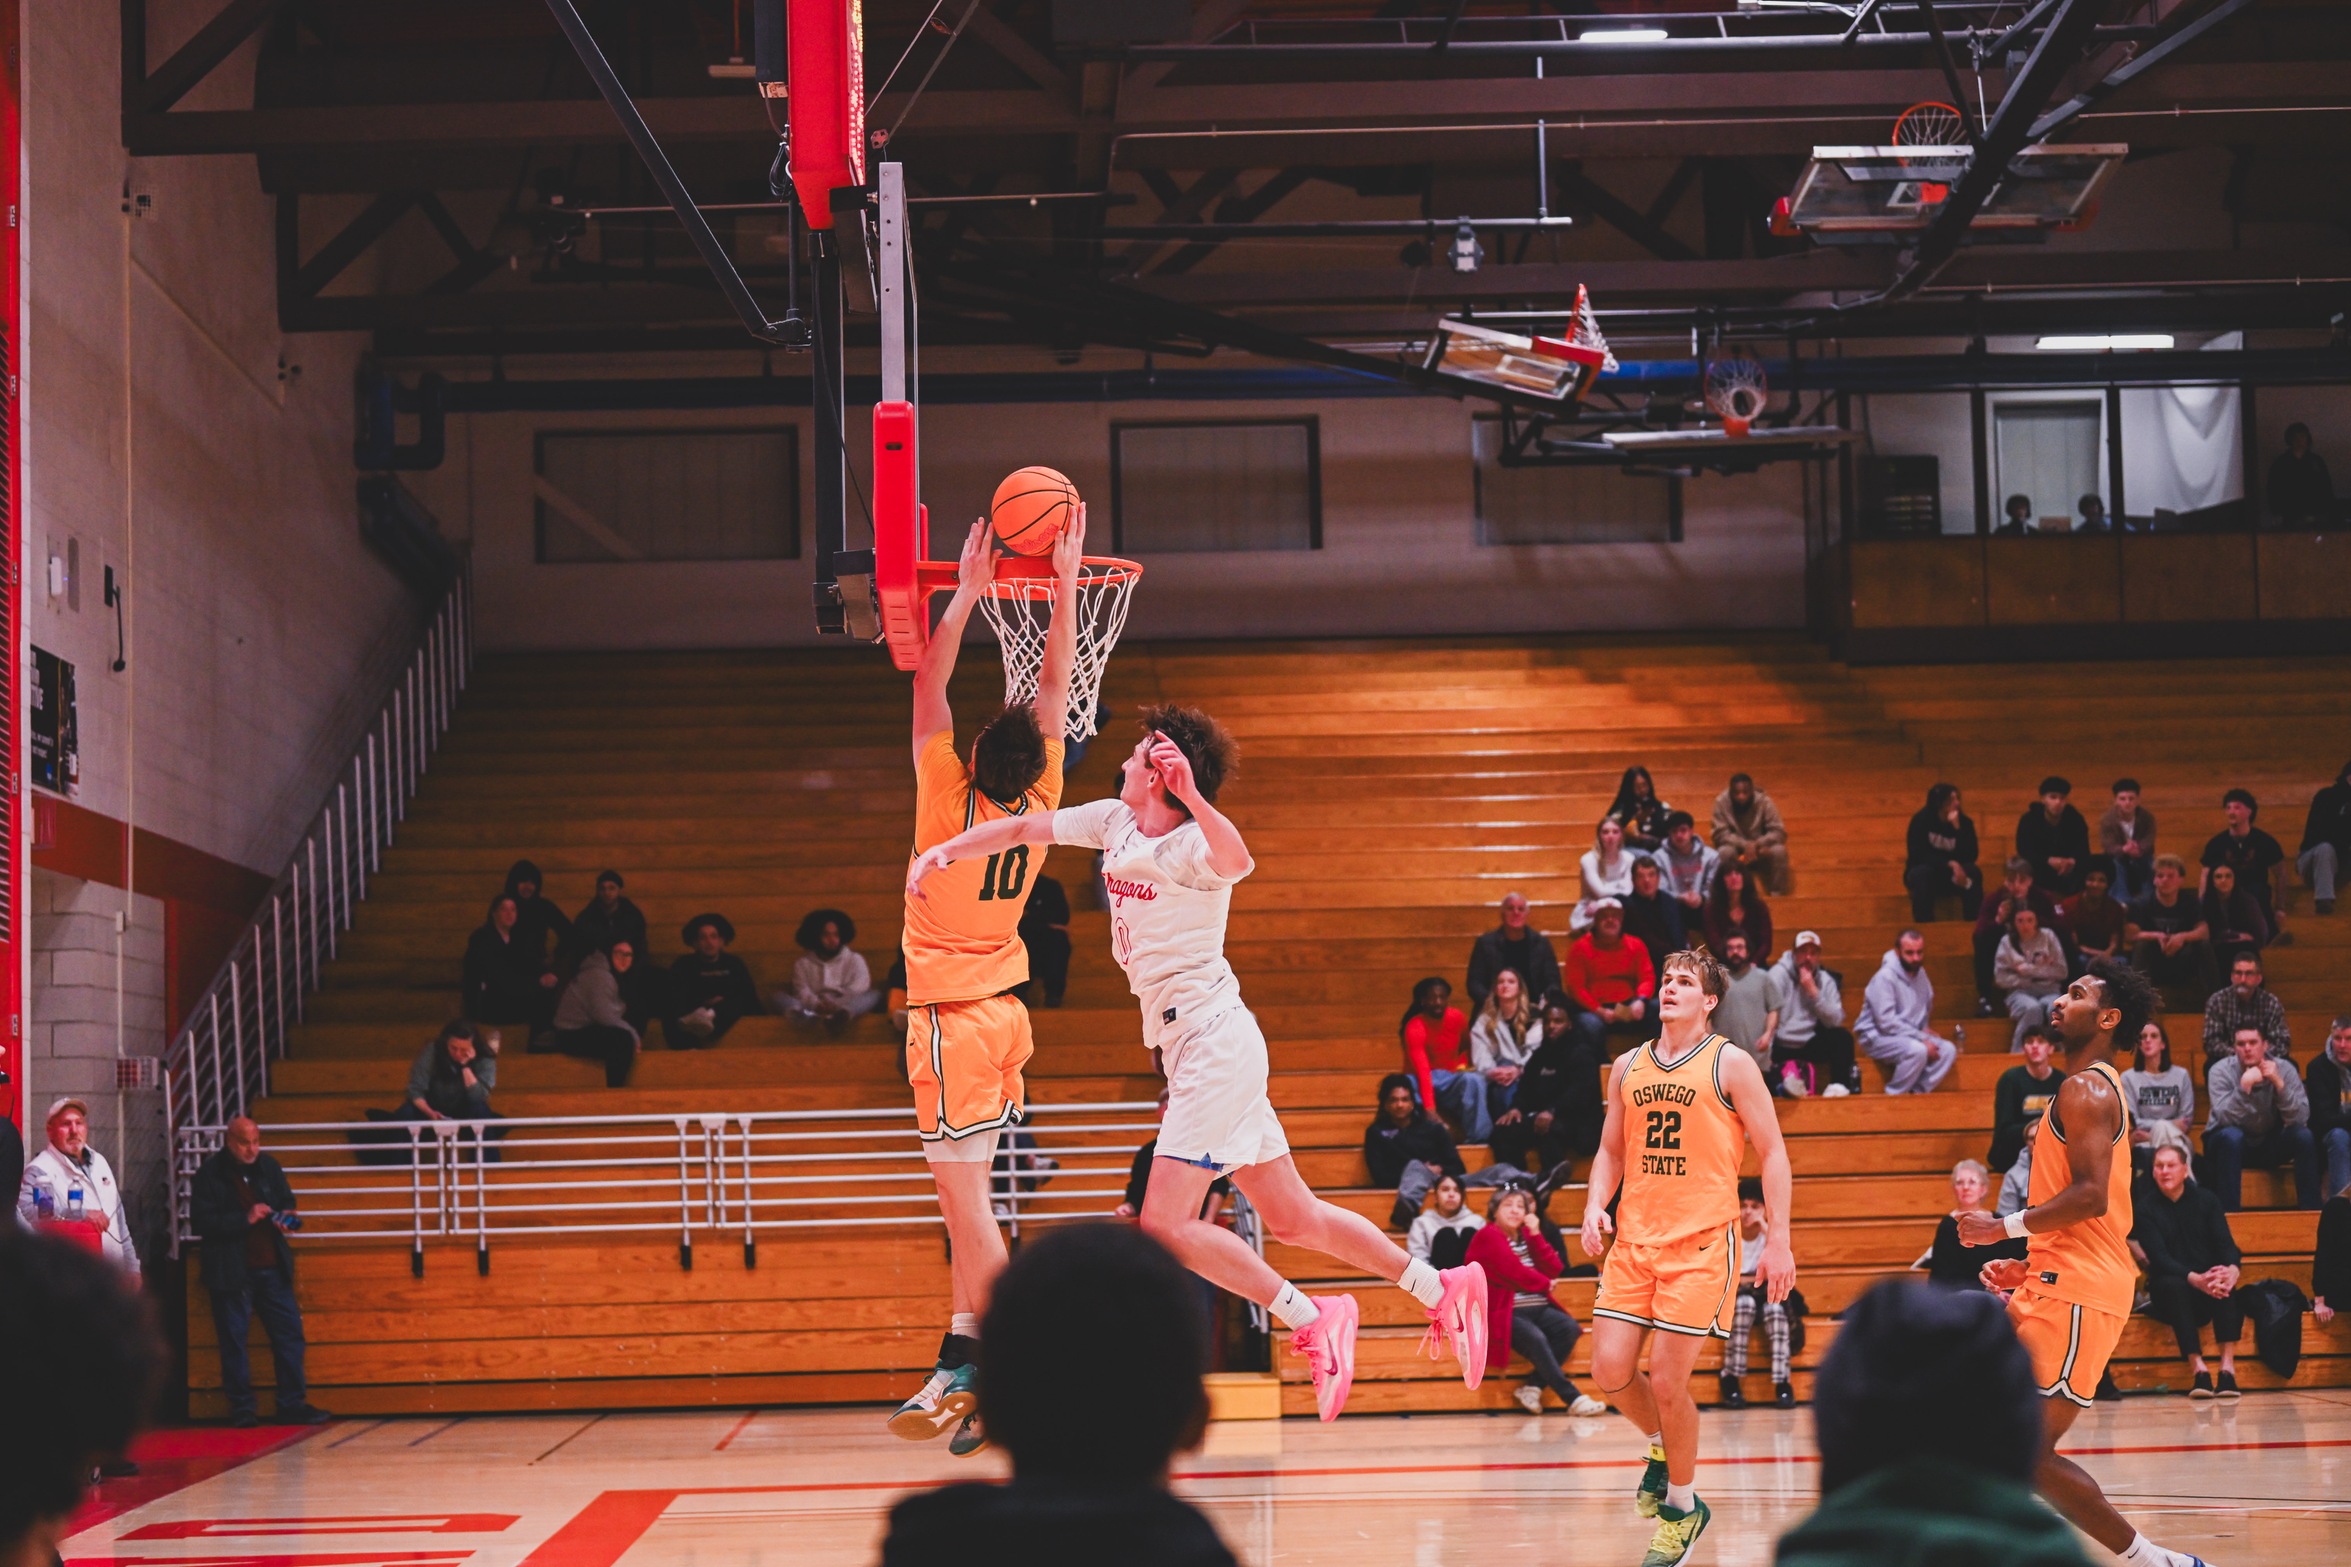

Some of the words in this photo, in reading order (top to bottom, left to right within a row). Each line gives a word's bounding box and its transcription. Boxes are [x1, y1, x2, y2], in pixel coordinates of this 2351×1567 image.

[978, 843, 1030, 901] 10
[1632, 1083, 1697, 1108] OSWEGO
[1645, 1110, 1682, 1150] 22
[1642, 1154, 1687, 1176] STATE
